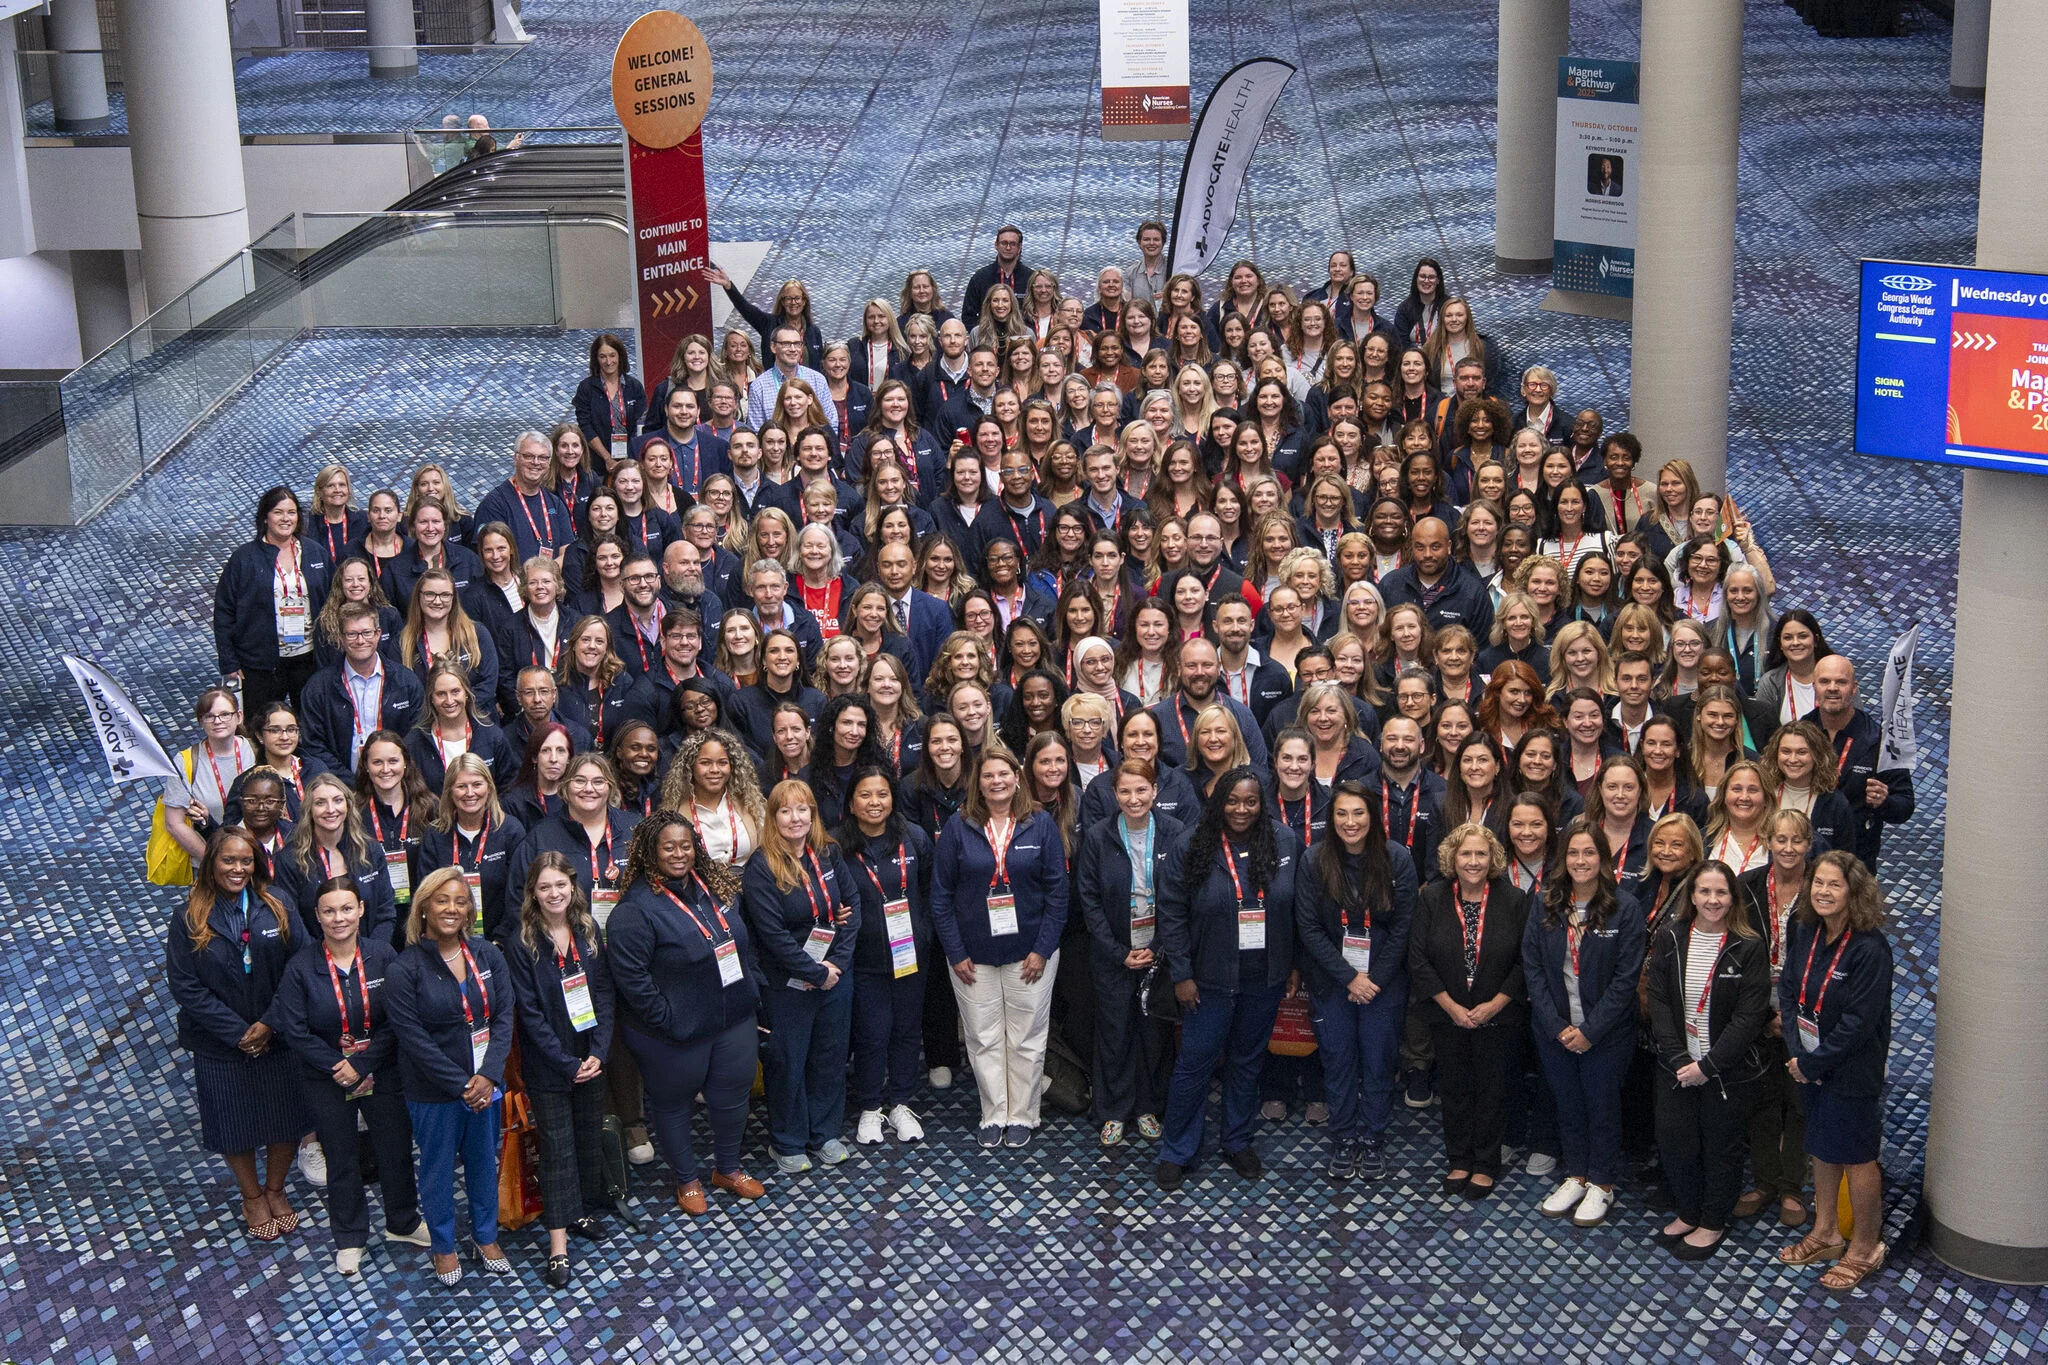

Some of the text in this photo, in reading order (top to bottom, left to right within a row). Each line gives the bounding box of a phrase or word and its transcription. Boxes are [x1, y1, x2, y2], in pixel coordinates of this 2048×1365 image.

[628, 46, 694, 70] WELCOME!
[1568, 66, 1603, 79] Magnet
[634, 70, 692, 92] GENERAL
[1577, 88, 1596, 97] 2025
[634, 92, 696, 115] SESSIONS
[1572, 121, 1606, 130] THURSDAY,
[639, 218, 703, 240] CONTINUE TO
[657, 239, 687, 257] MAIN
[643, 256, 704, 281] ENTRANCE
[1610, 265, 1634, 274] Nurses
[1882, 291, 1932, 305] Georgia World
[1960, 286, 2037, 307] Wednesday
[1877, 302, 1935, 316] Congress Center
[1889, 313, 1923, 327] Authority
[1875, 377, 1905, 387] SIGNIA
[1874, 388, 1904, 398] HOTEL
[84, 679, 124, 753] ADVOCATE
